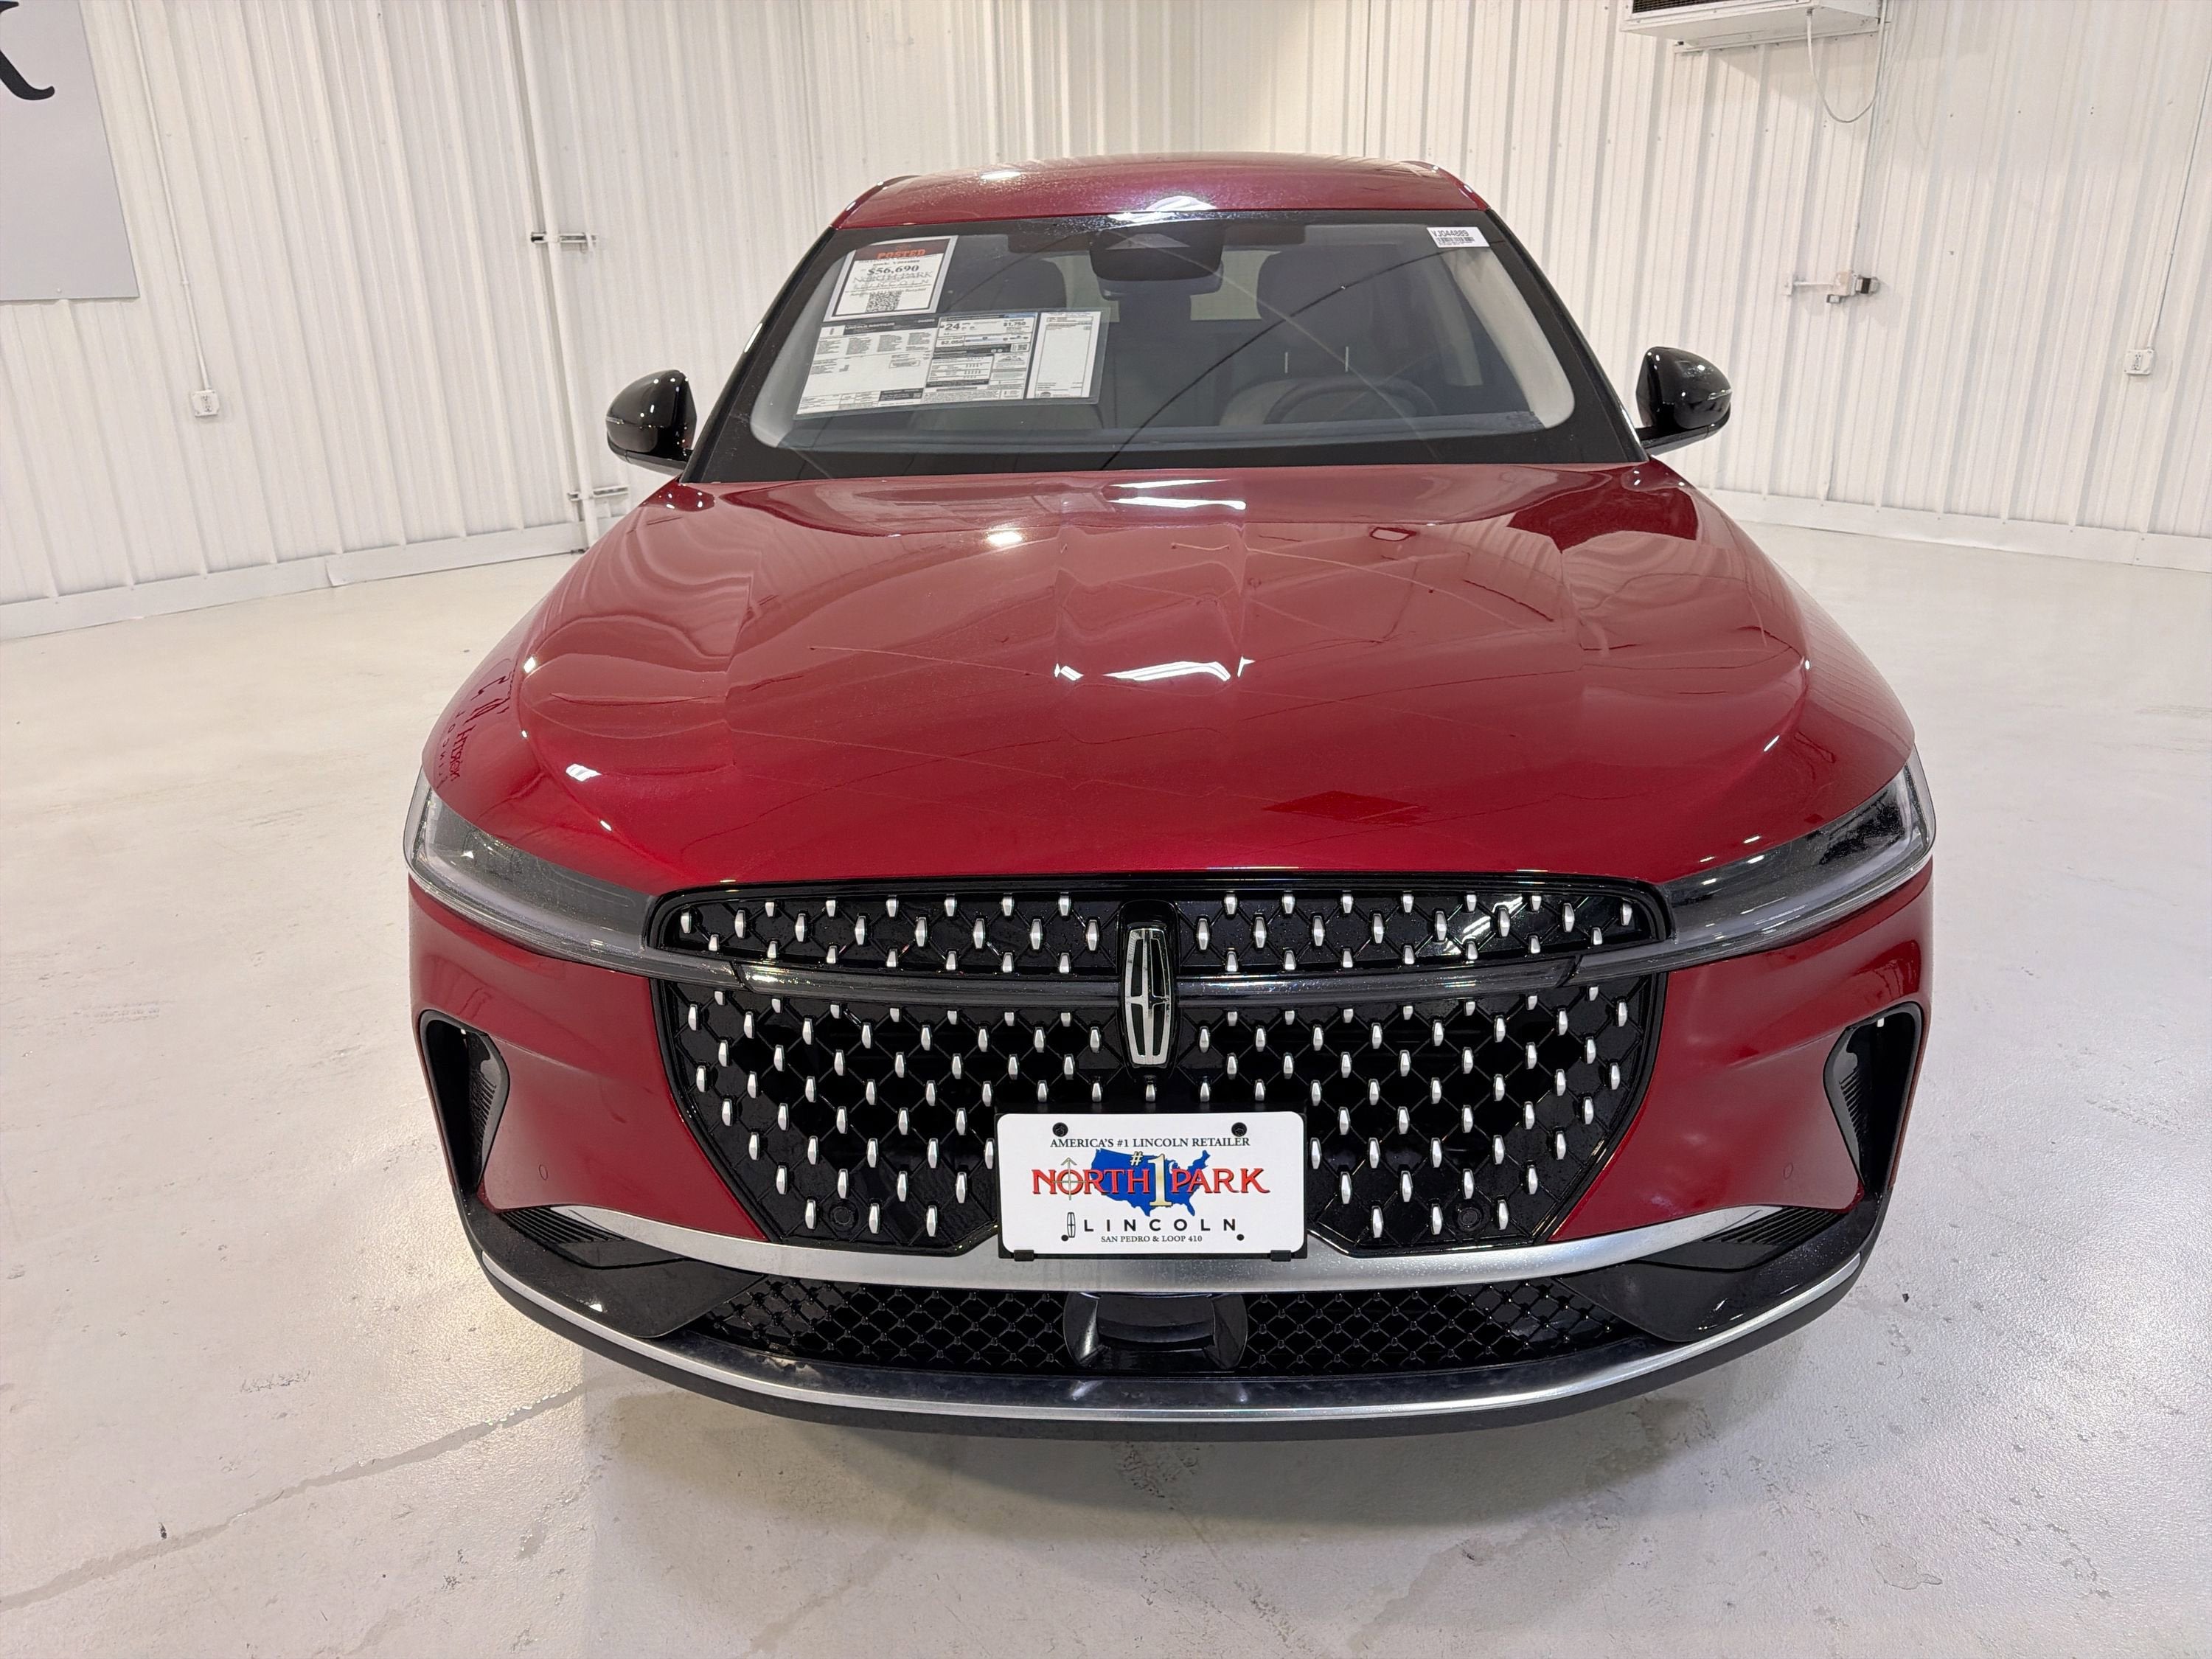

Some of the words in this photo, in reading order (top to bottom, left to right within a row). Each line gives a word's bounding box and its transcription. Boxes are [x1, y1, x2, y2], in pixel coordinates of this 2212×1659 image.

[877, 248, 926, 260] POSTED
[867, 265, 919, 276] $56,690
[1050, 1138, 1114, 1147] AMERICA'S
[1116, 1138, 1129, 1147] #1
[1133, 1138, 1190, 1147] LINCOLN
[1192, 1137, 1251, 1147] RETAILER
[1032, 1168, 1150, 1194] NORTH
[1171, 1168, 1271, 1194] PARK
[1085, 1218, 1236, 1232] LINCOLN
[1101, 1235, 1119, 1243] SAN
[1120, 1235, 1150, 1243] PEDRO
[1152, 1235, 1160, 1243] &
[1161, 1235, 1186, 1243] LOOP
[1188, 1235, 1203, 1243] 410
